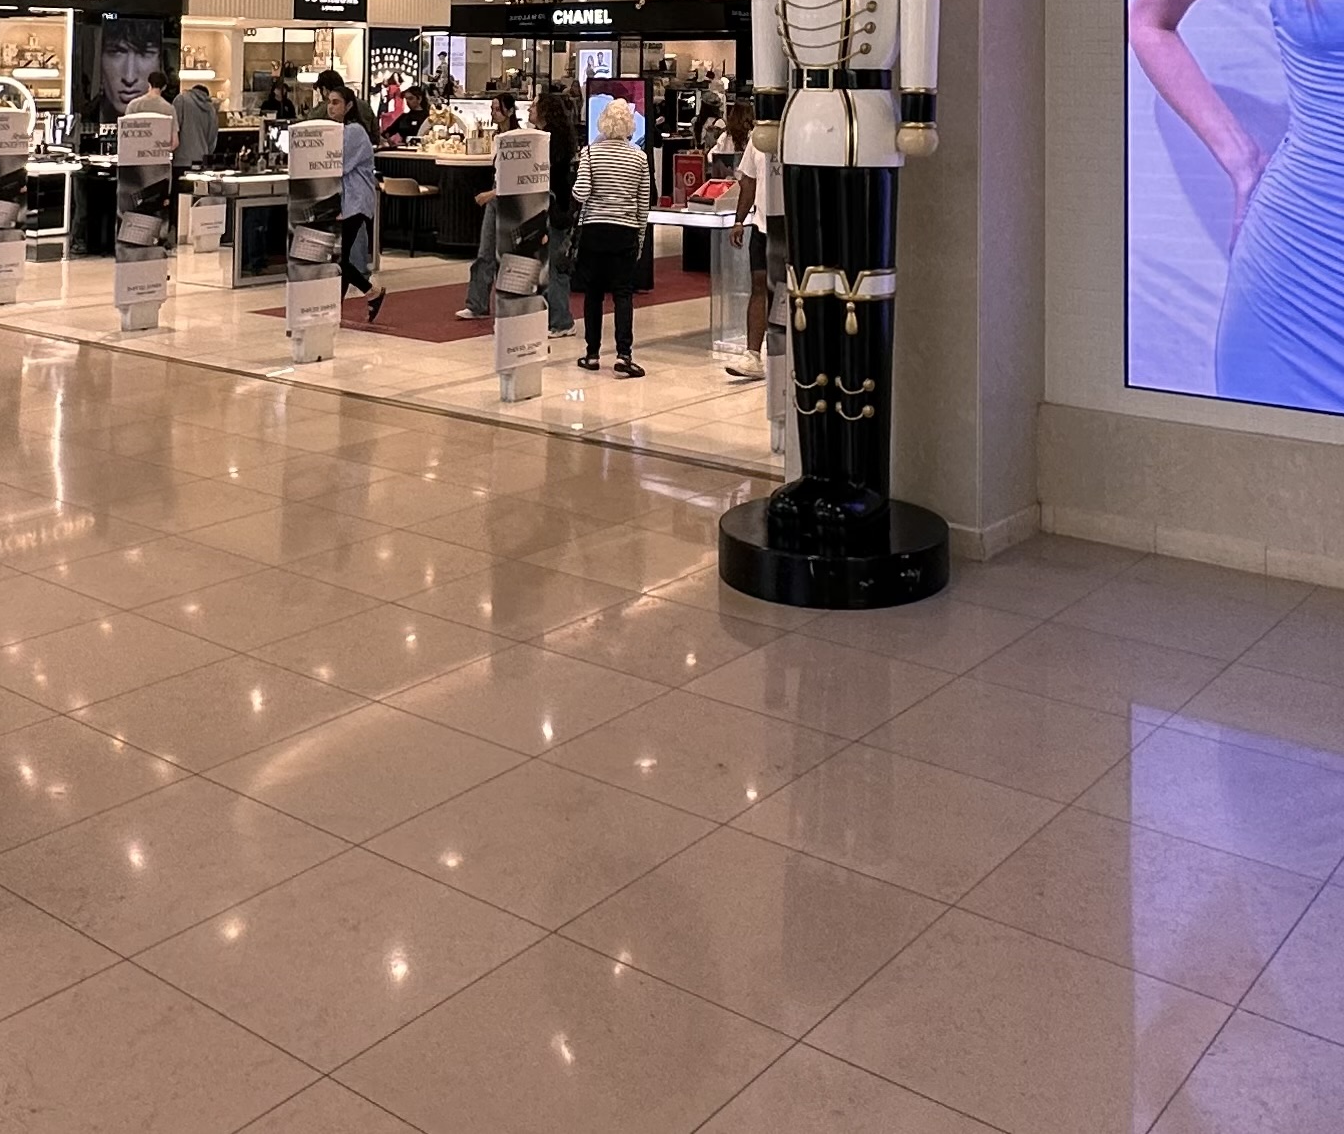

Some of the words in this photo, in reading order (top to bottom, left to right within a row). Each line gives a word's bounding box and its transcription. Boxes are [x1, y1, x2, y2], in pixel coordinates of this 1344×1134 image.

[553, 9, 613, 25] CHANEL
[292, 140, 325, 148] ACCESS
[500, 151, 532, 161] ACCESS
